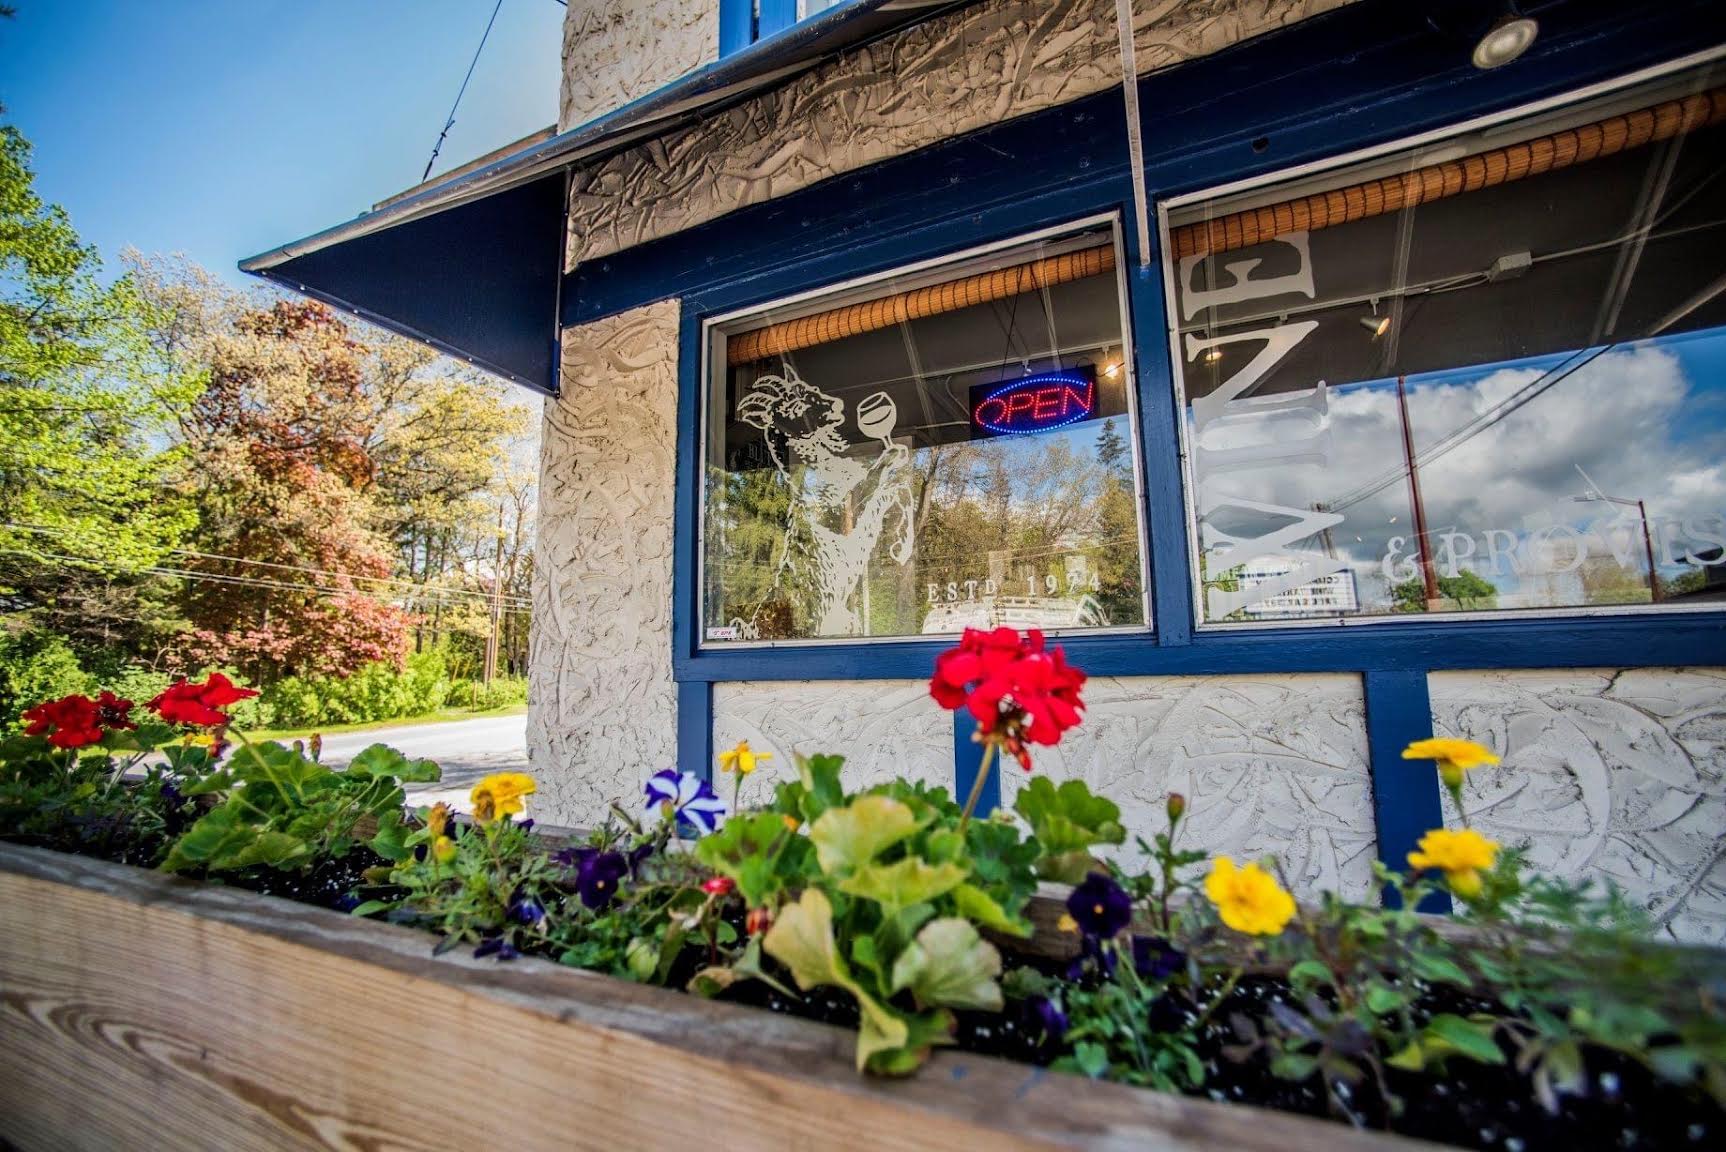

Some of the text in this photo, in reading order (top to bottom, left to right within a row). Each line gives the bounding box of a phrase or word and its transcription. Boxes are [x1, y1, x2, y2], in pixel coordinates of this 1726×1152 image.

[975, 382, 1093, 424] OPEN
[1180, 230, 1345, 619] WINE
[1382, 535, 1427, 583] &
